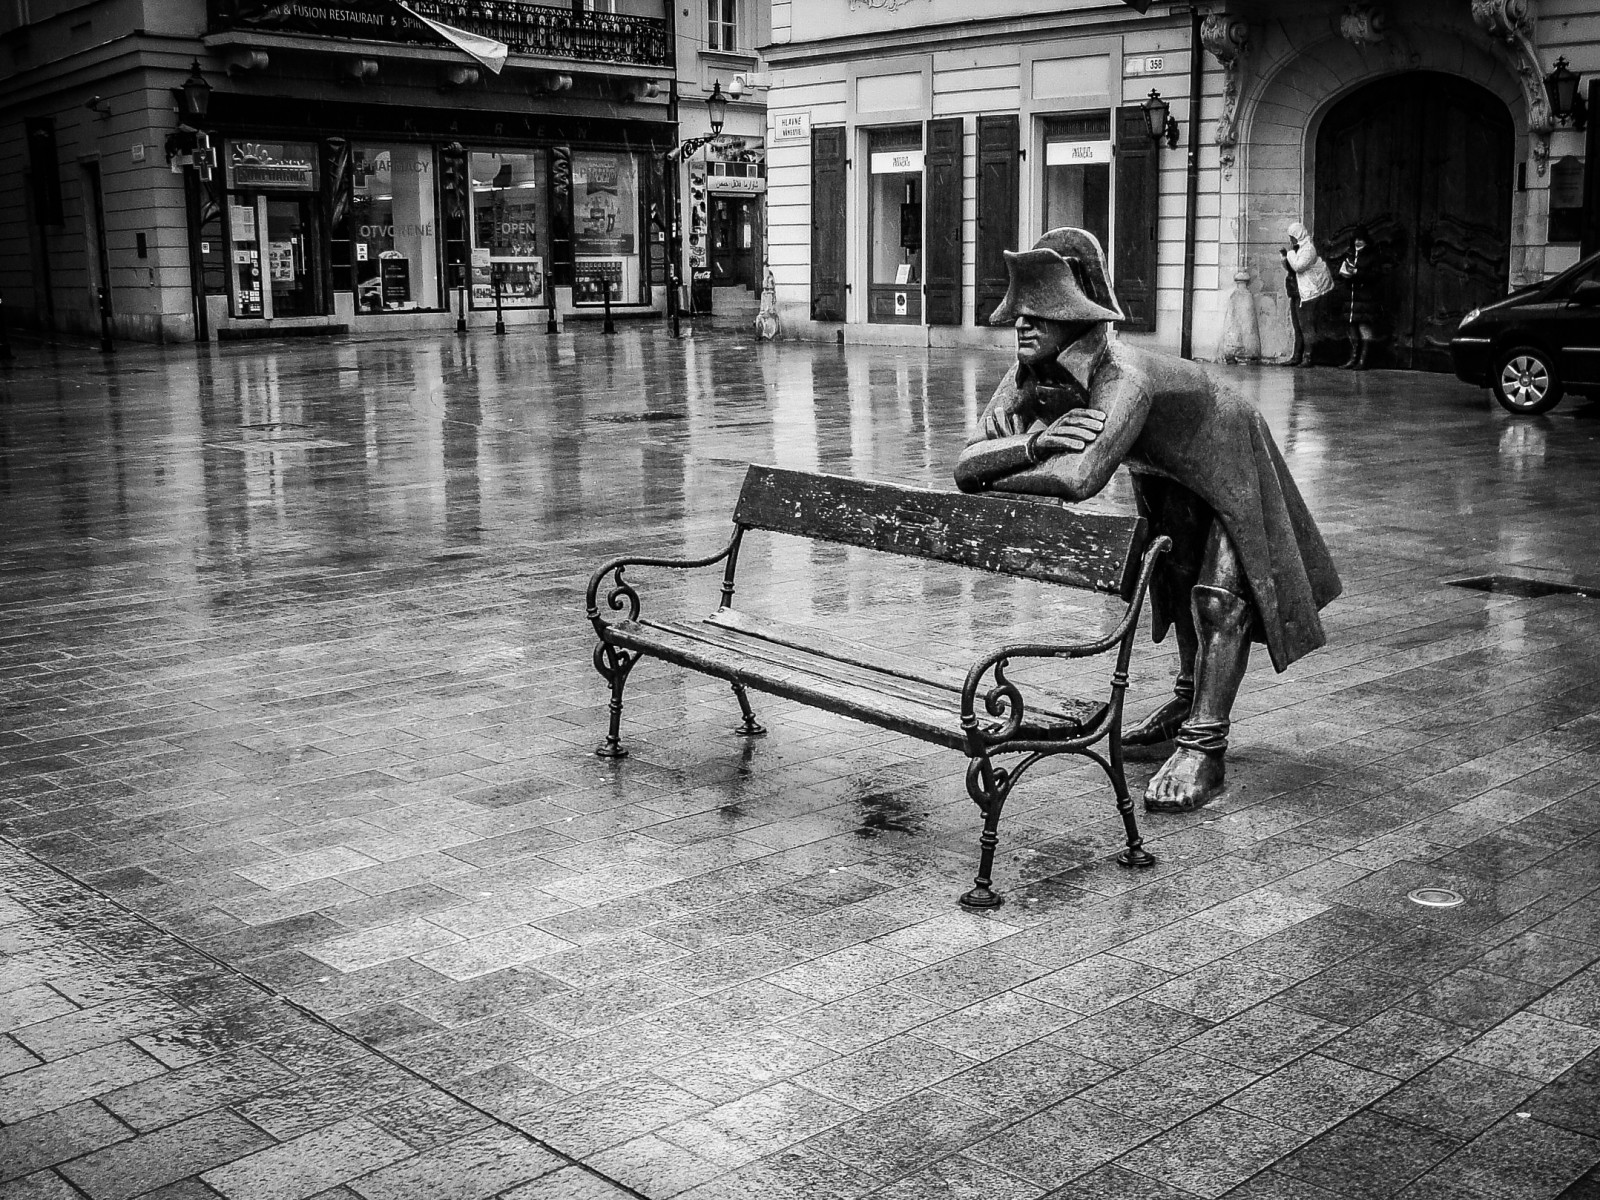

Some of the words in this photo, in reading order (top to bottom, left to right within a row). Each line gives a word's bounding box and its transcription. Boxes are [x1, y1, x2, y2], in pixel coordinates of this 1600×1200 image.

[283, 4, 292, 15] &
[293, 4, 328, 19] FUSION
[329, 9, 384, 26] RESTAURANT
[1150, 59, 1163, 69] 358
[361, 159, 430, 174] PHARMACY
[360, 221, 434, 239] OTVORENÉ
[501, 222, 536, 235] OPEN
